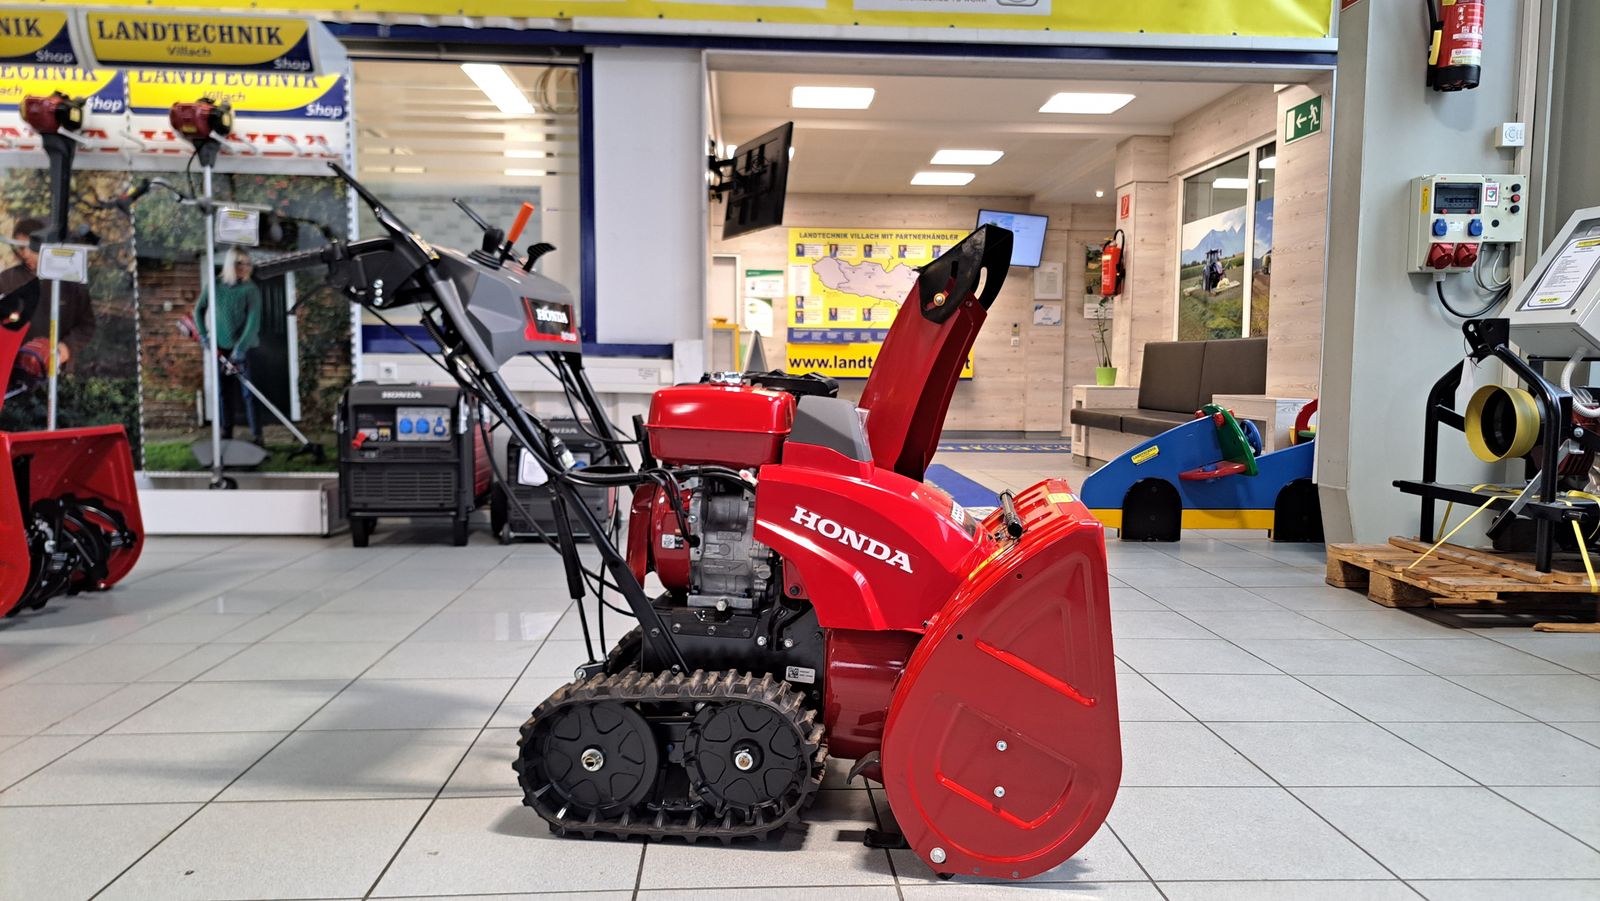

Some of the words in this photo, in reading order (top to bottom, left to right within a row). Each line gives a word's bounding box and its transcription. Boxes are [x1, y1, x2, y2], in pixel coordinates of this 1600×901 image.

[97, 20, 284, 46] LANDTECHNIK
[35, 50, 74, 63] Shop
[166, 46, 212, 58] Villach
[273, 58, 311, 71] Shop
[136, 70, 320, 89] LANDTECHNIK
[86, 96, 123, 112] Shop
[304, 103, 343, 119] Shop
[535, 307, 568, 324] HONDA
[381, 390, 423, 399] HONDA
[790, 505, 913, 574] HONDA
